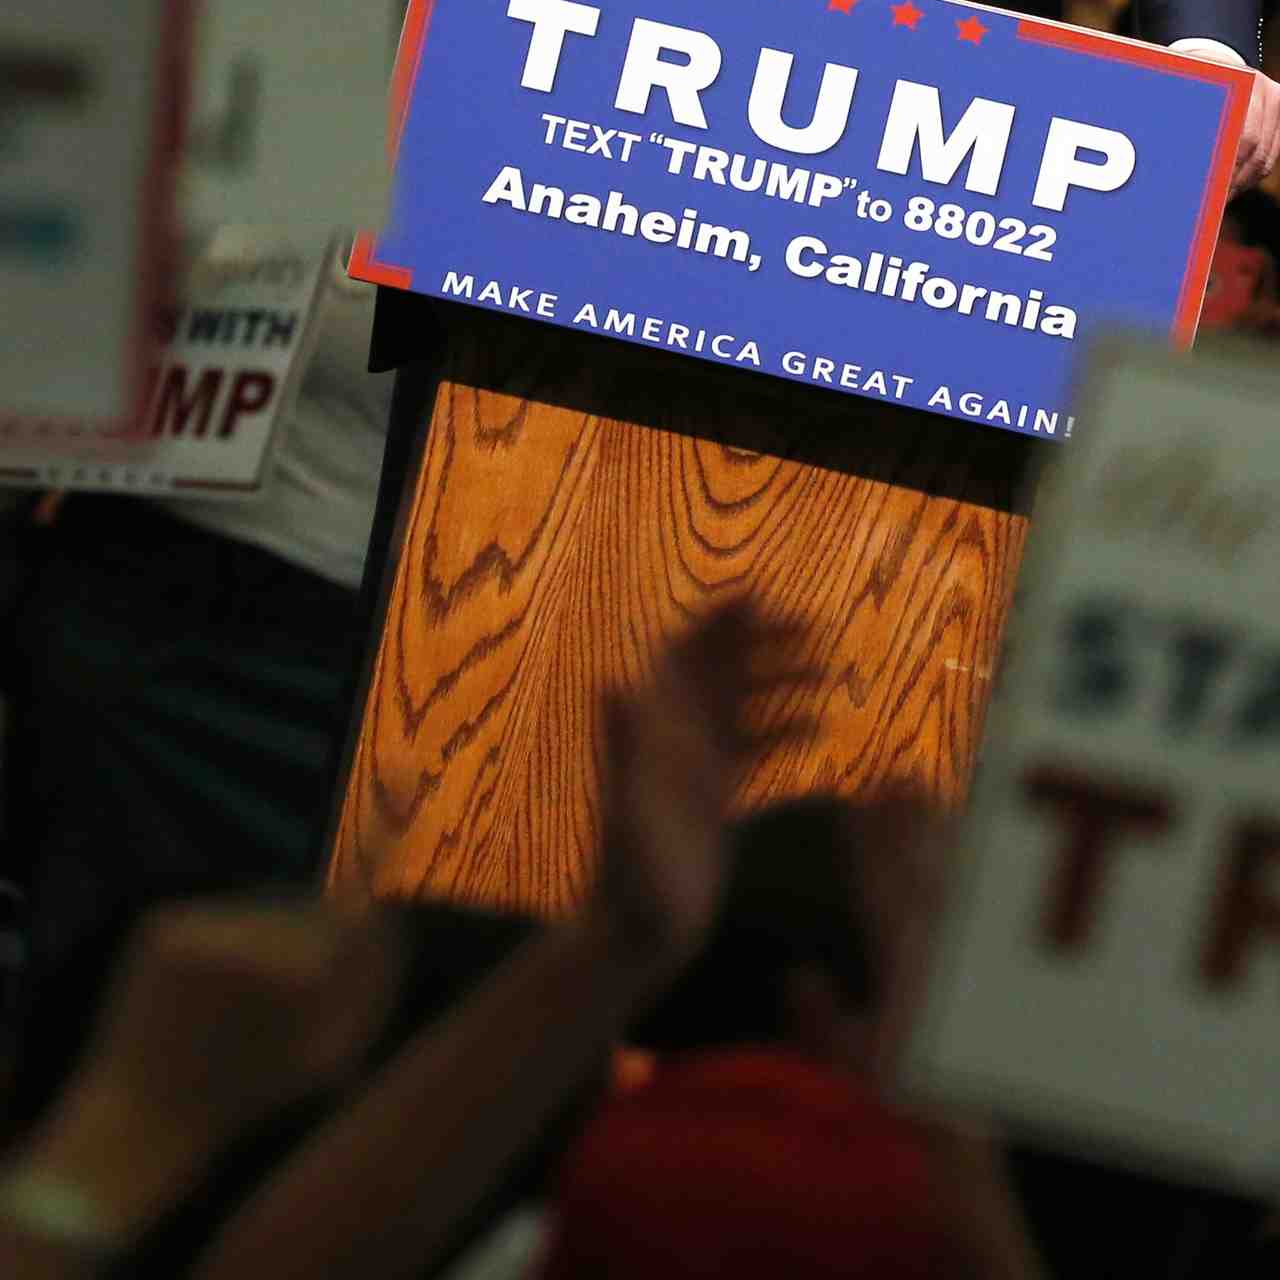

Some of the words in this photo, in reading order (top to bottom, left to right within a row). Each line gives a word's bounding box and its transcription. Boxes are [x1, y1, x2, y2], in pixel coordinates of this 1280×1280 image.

[482, 166, 762, 272] Anaheim,
[785, 235, 1077, 339] California
[542, 114, 642, 163] TEXT
[857, 191, 893, 223] to
[903, 196, 1057, 262] 88022
[441, 271, 558, 318] MAKE
[572, 303, 761, 366] AMERICA
[782, 351, 914, 404] GREAT
[927, 385, 1077, 438] AGAIN!
